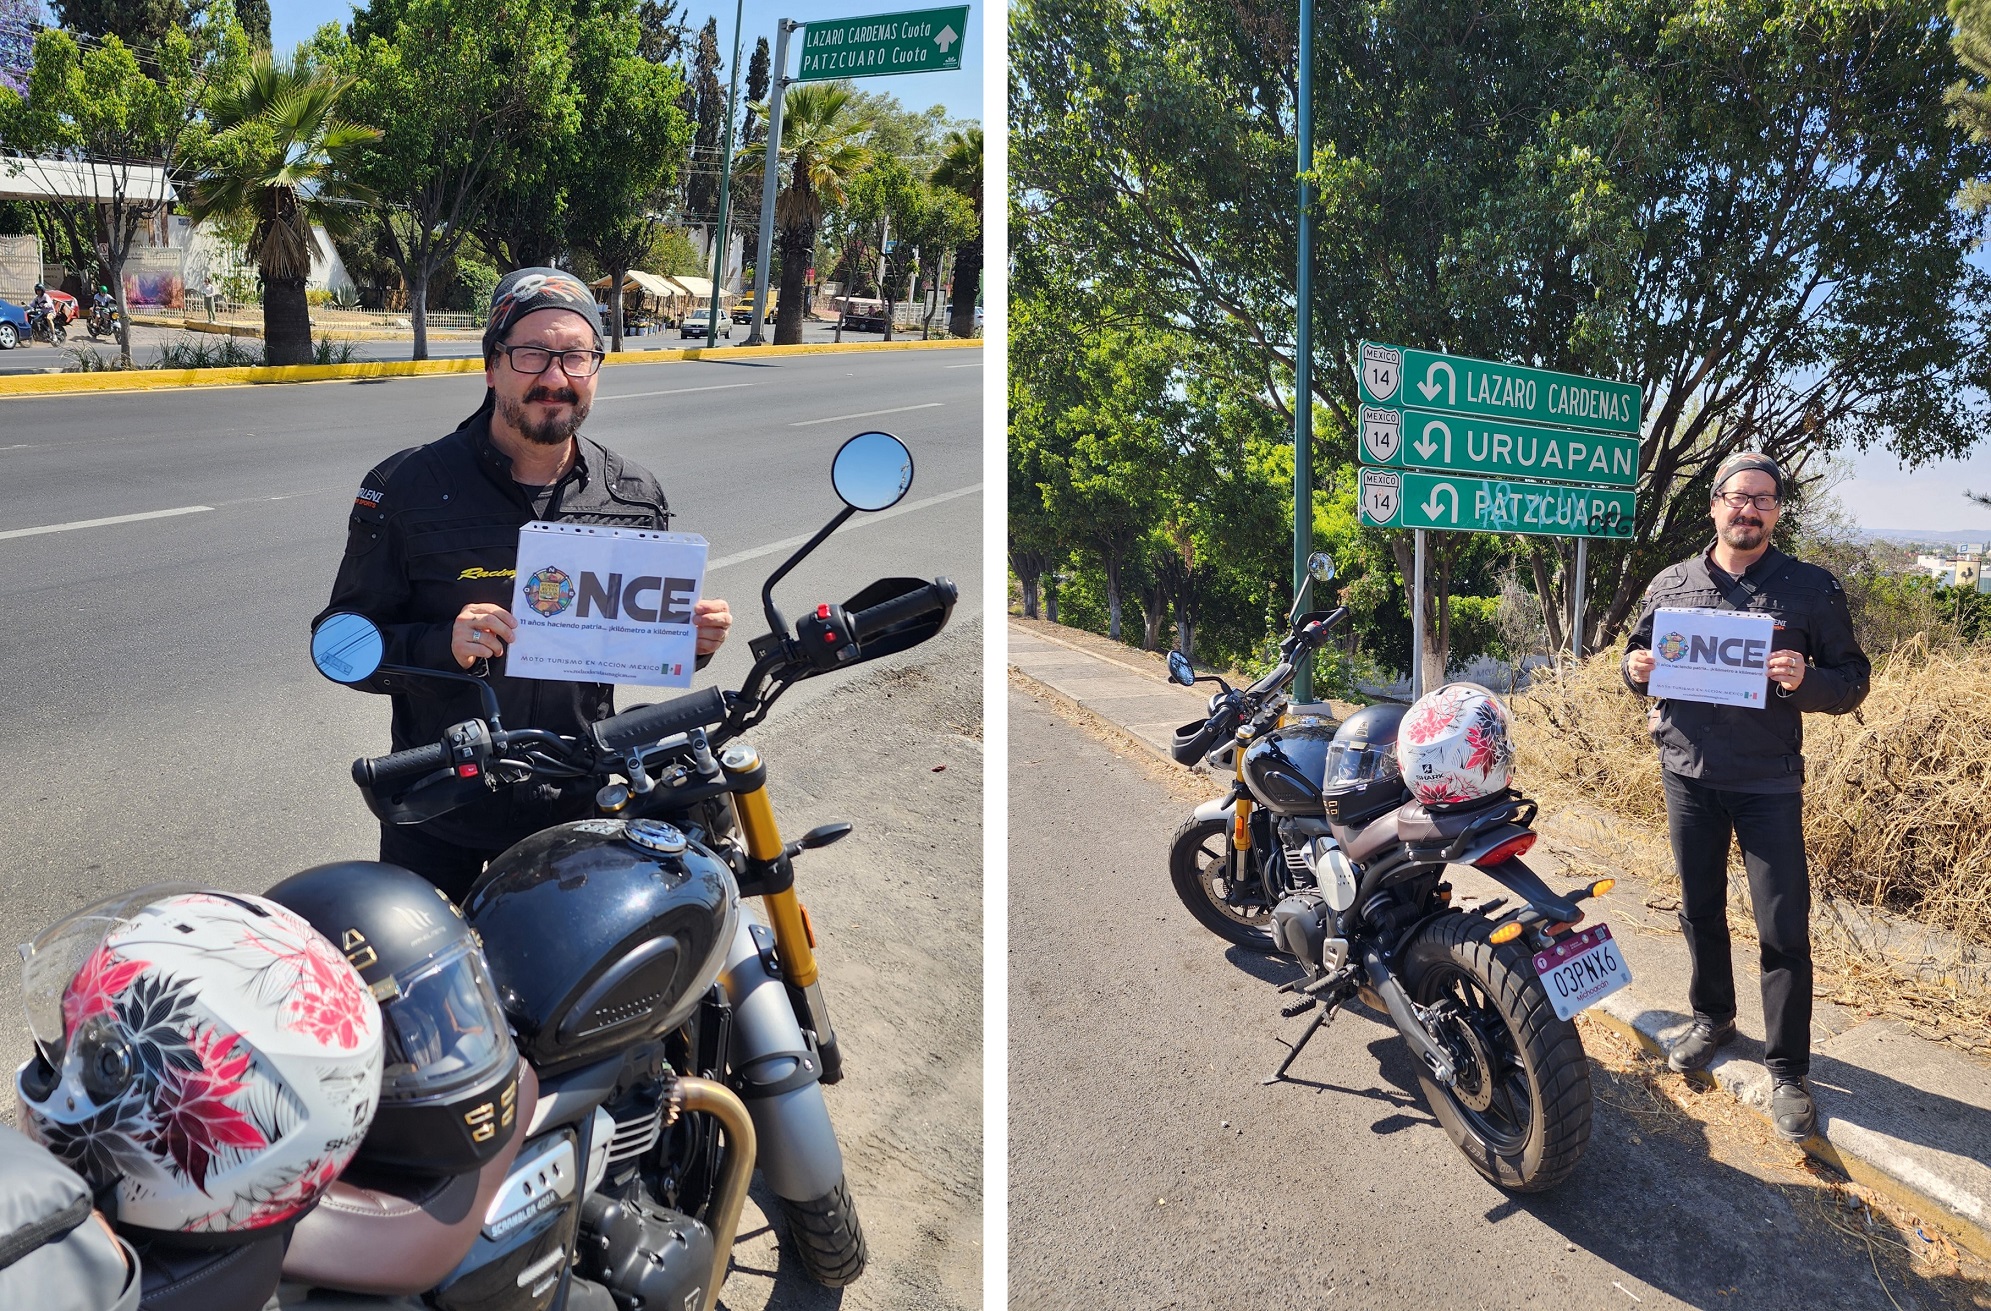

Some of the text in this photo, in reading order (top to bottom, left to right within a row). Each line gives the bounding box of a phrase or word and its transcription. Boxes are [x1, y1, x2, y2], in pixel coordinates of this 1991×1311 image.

[806, 21, 931, 48] LAZARO CARDENAS Cuota
[803, 47, 927, 72] PATZCUARO Cuota
[1366, 349, 1397, 361] MEXICO
[1373, 368, 1389, 386] 14
[1467, 371, 1630, 423] LAZARO CARDENAS
[1366, 411, 1397, 423] MEXICO
[1373, 431, 1390, 448] 14
[1467, 430, 1632, 476] URUAPAN
[1366, 475, 1396, 486] MEXICO
[1373, 493, 1390, 511] 14
[1474, 490, 1622, 528] PATZCUARO
[527, 619, 546, 628] años
[546, 621, 580, 630] haciendo
[520, 655, 545, 663] MOTO
[547, 657, 583, 666] TURISMO
[1415, 772, 1444, 781] SHARK
[1553, 946, 1617, 998] 03PNX6
[1576, 980, 1609, 1002] Michoacán
[491, 1205, 538, 1238] SCRAMBLER
